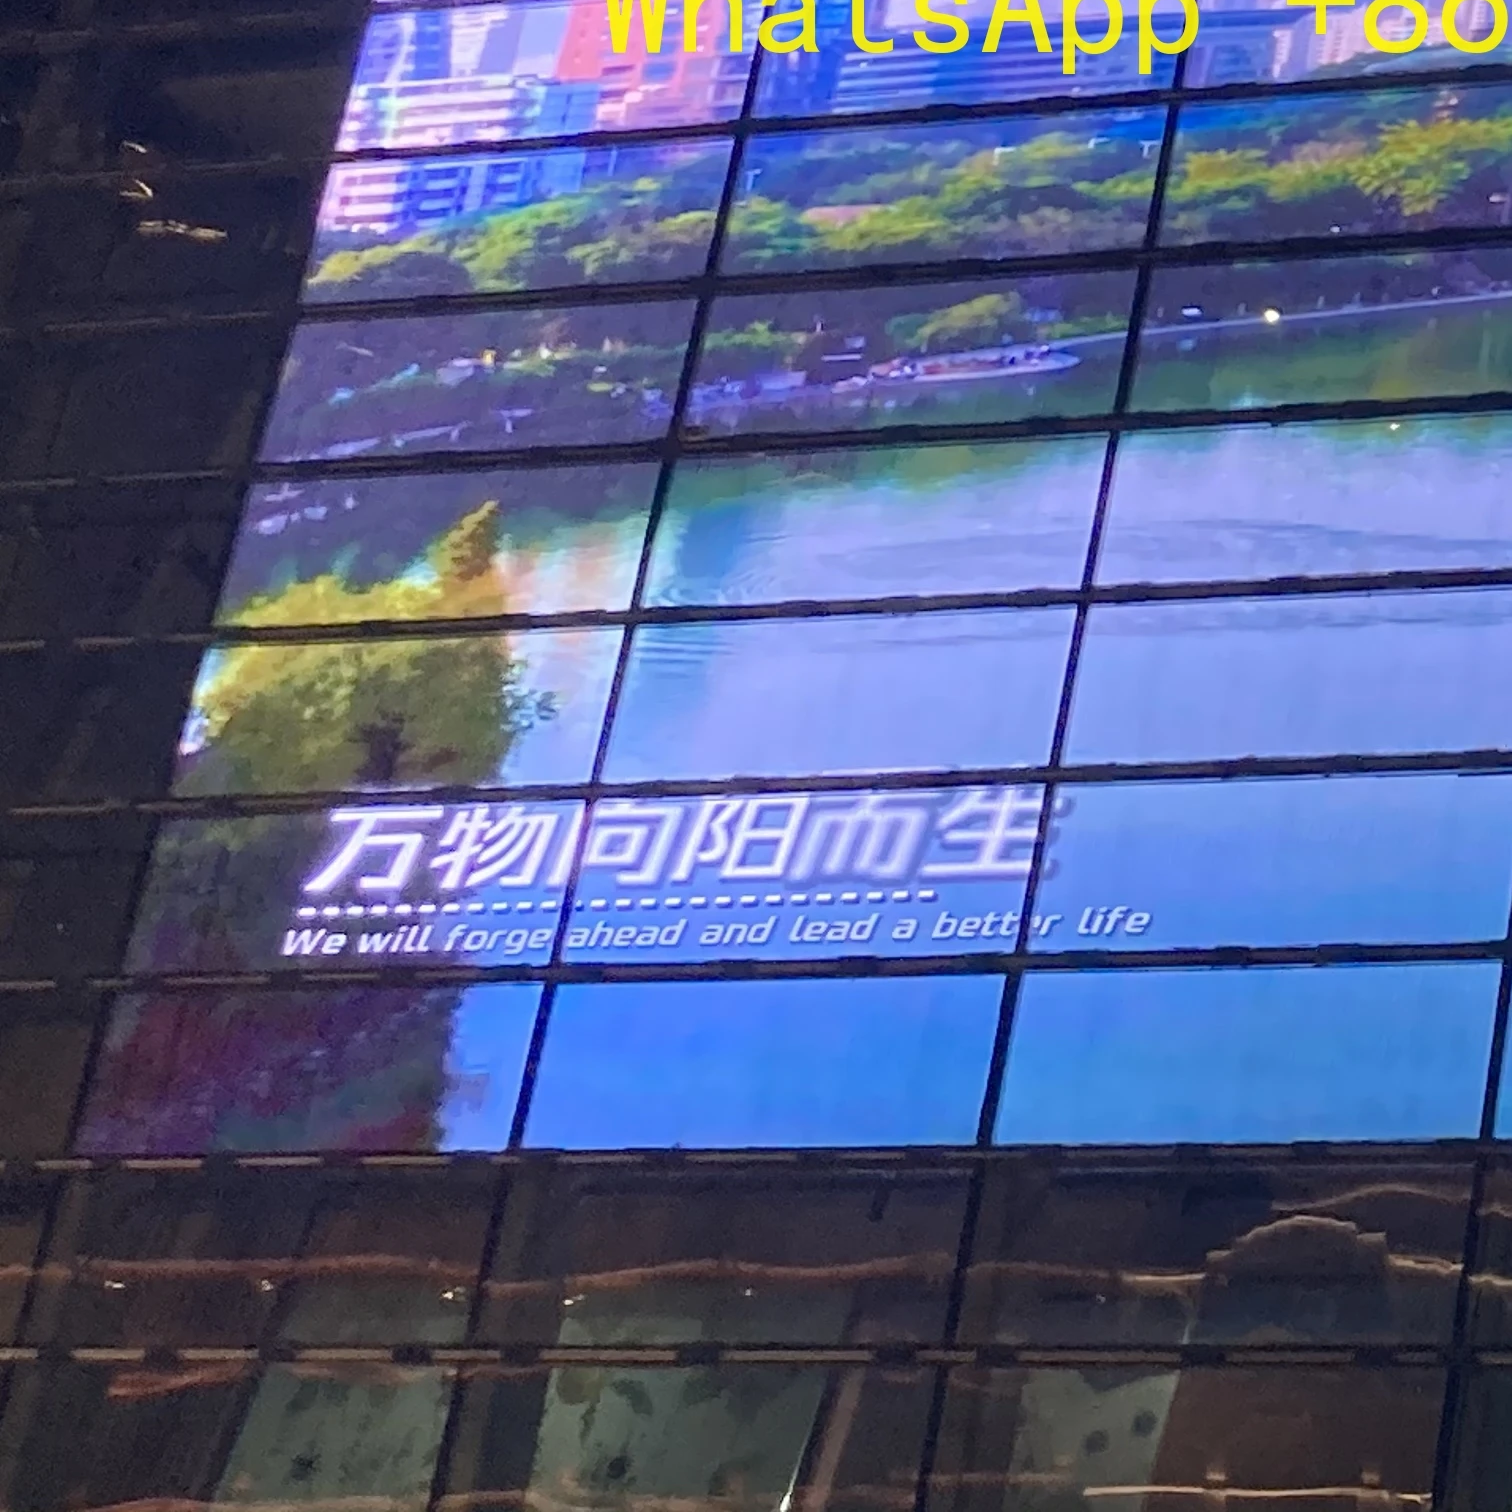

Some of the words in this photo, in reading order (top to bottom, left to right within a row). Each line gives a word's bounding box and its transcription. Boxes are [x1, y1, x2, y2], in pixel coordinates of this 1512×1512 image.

[303, 787, 1060, 892] 万物向阳而生
[282, 928, 346, 956] We
[357, 923, 434, 953] will
[444, 923, 551, 955] forge
[567, 918, 688, 949] ahead
[699, 915, 778, 945] and
[788, 912, 880, 943] lead
[892, 917, 918, 940] a
[1076, 905, 1151, 936] life
